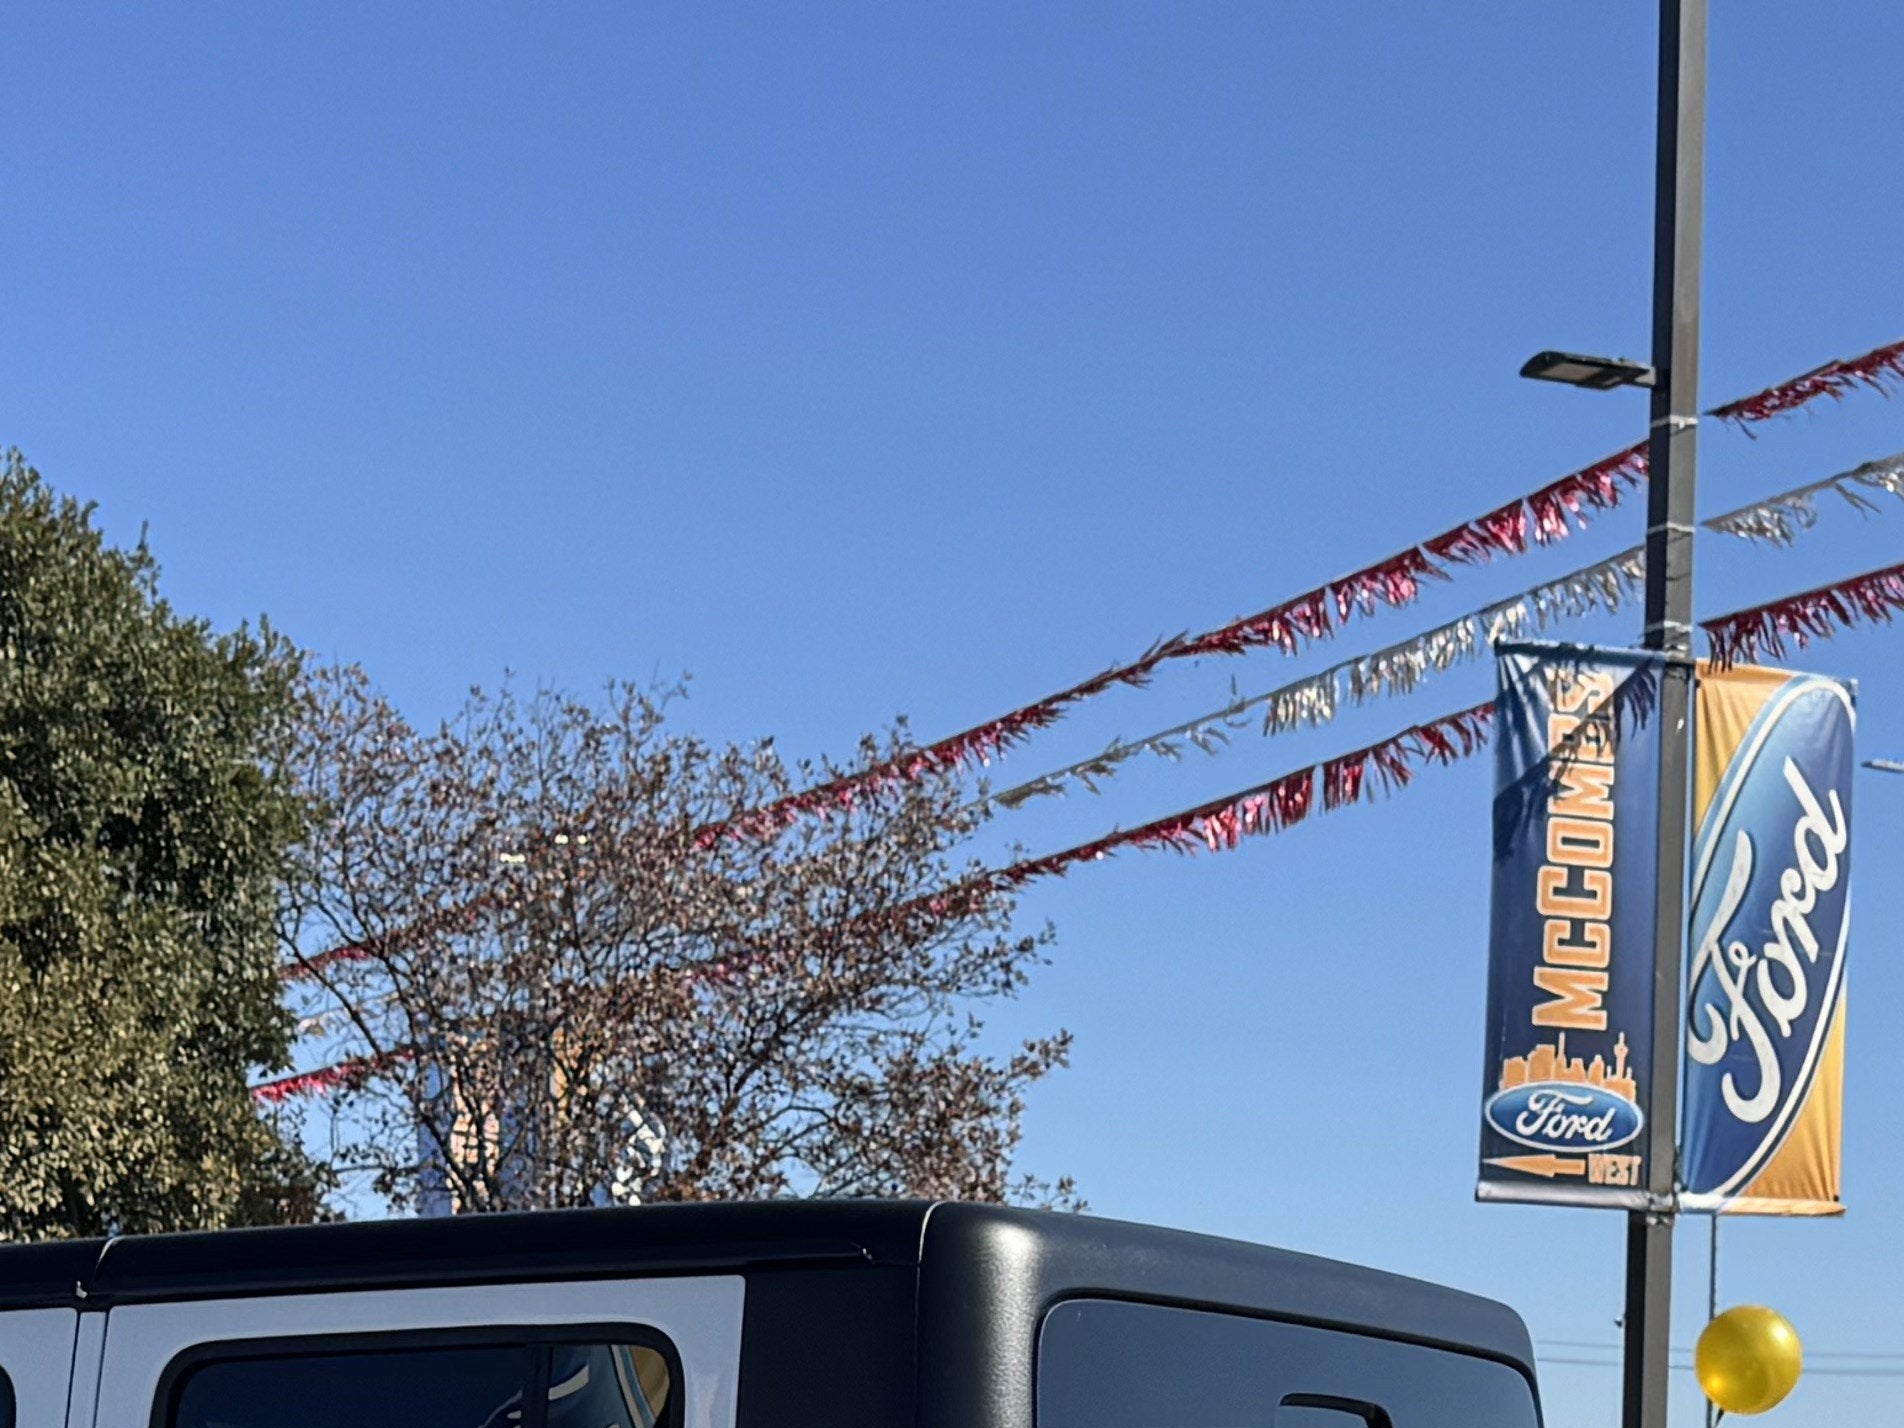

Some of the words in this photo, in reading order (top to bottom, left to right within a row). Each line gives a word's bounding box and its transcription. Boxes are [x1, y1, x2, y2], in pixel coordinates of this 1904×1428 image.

[1689, 756, 1849, 1124] Ford
[1516, 1092, 1614, 1142] Ford
[1587, 1153, 1643, 1187] WEST
